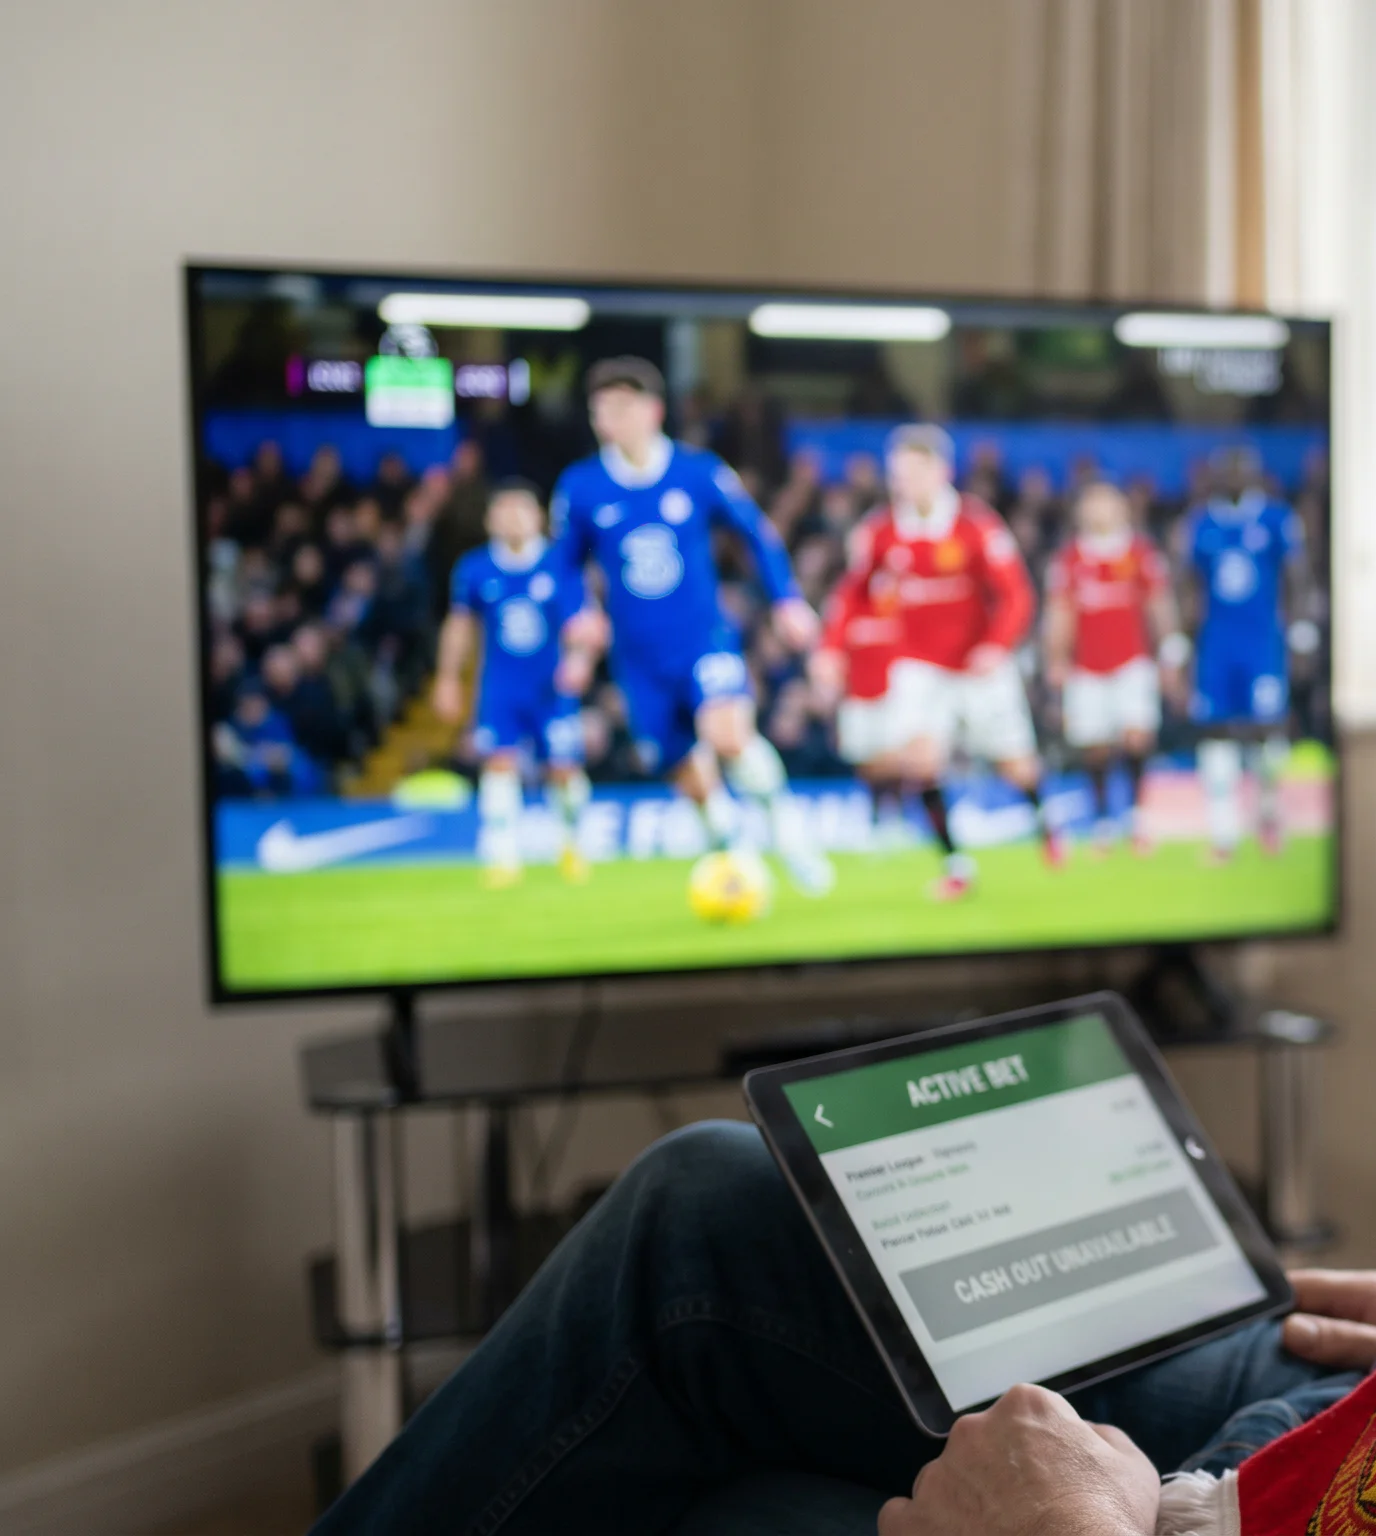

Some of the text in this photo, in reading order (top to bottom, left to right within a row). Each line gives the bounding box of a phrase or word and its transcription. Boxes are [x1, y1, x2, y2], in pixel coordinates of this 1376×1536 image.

[906, 1054, 1029, 1108] ACTIVE BET
[953, 1265, 1013, 1304] CASH
[1010, 1253, 1052, 1286] OUT
[1051, 1212, 1179, 1274] UNAVAILABLE
